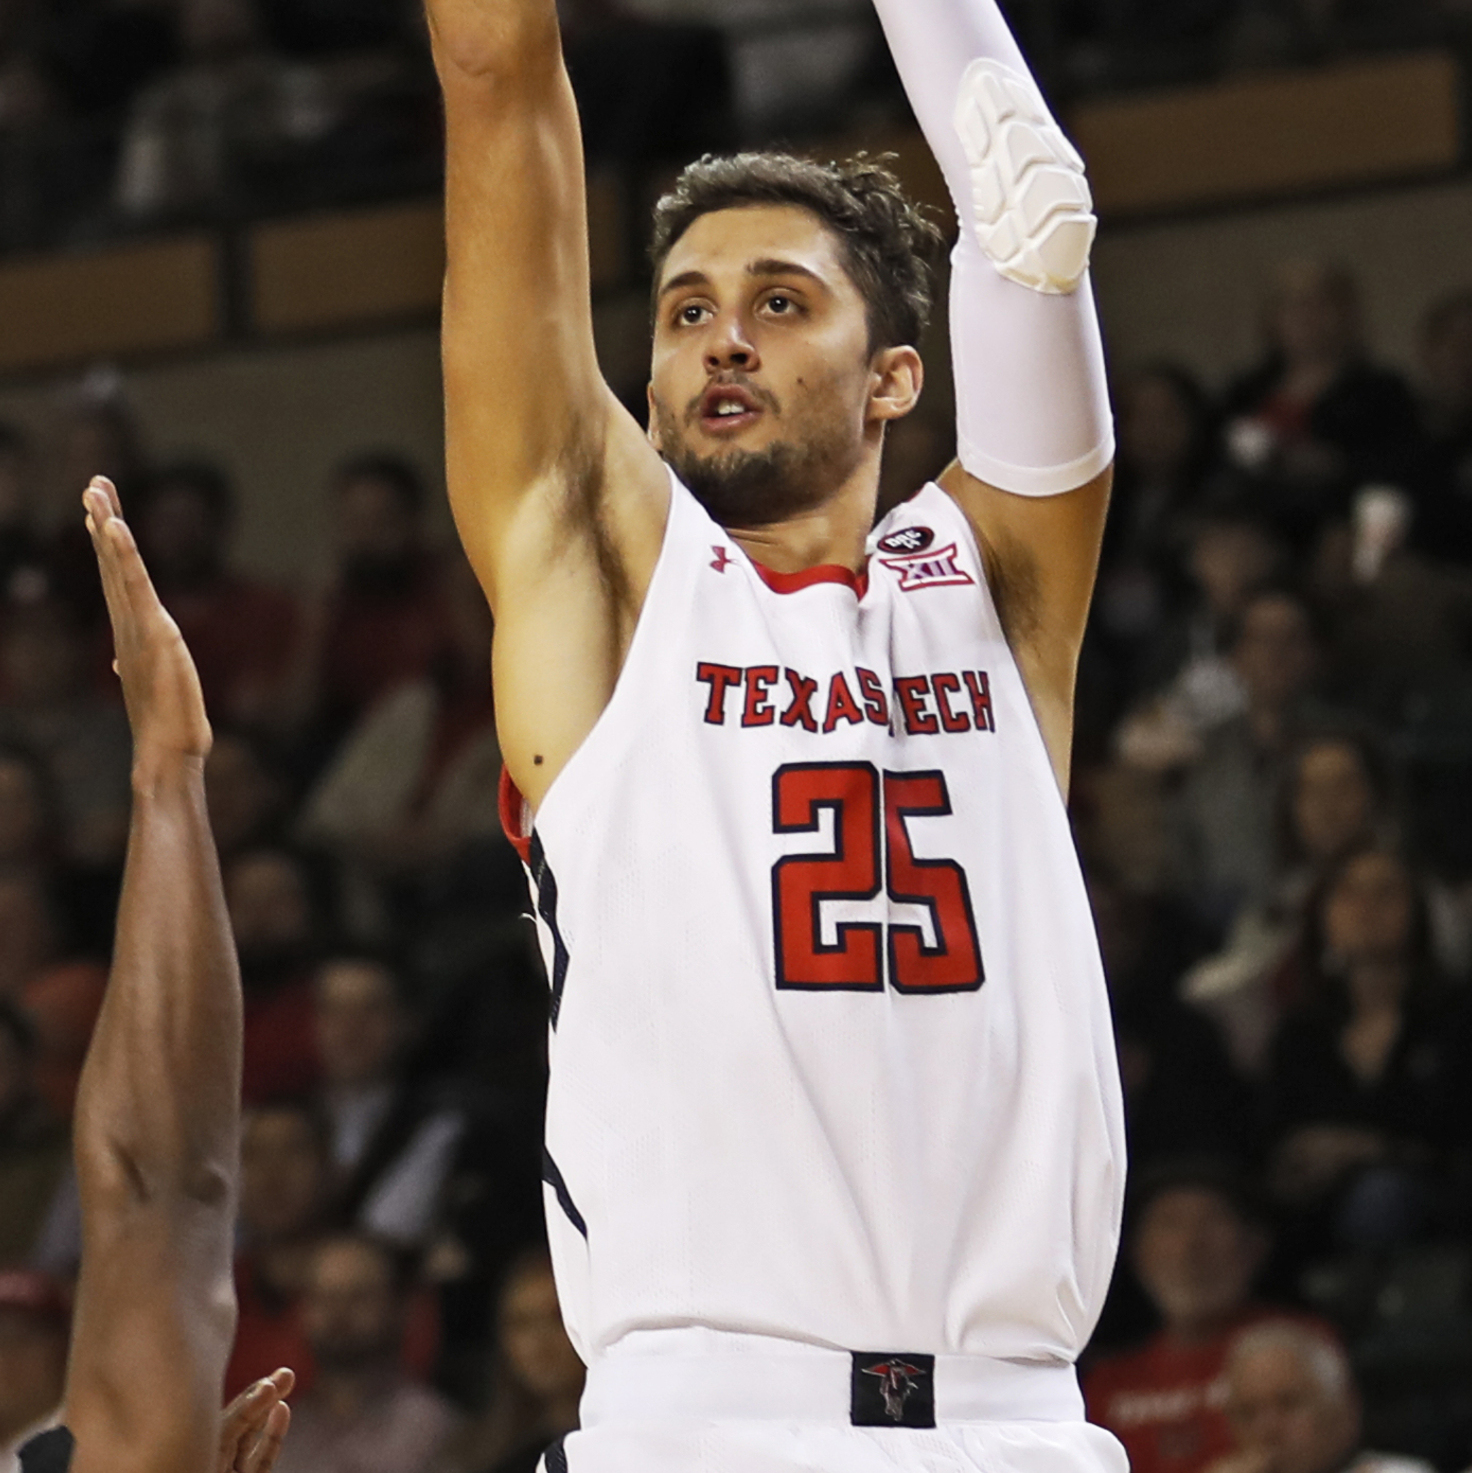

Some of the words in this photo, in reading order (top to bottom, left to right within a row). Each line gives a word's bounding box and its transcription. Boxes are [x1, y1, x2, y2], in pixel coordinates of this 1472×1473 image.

[696, 661, 890, 734] TEXAS
[889, 670, 996, 737] ECH
[771, 760, 986, 995] 25
